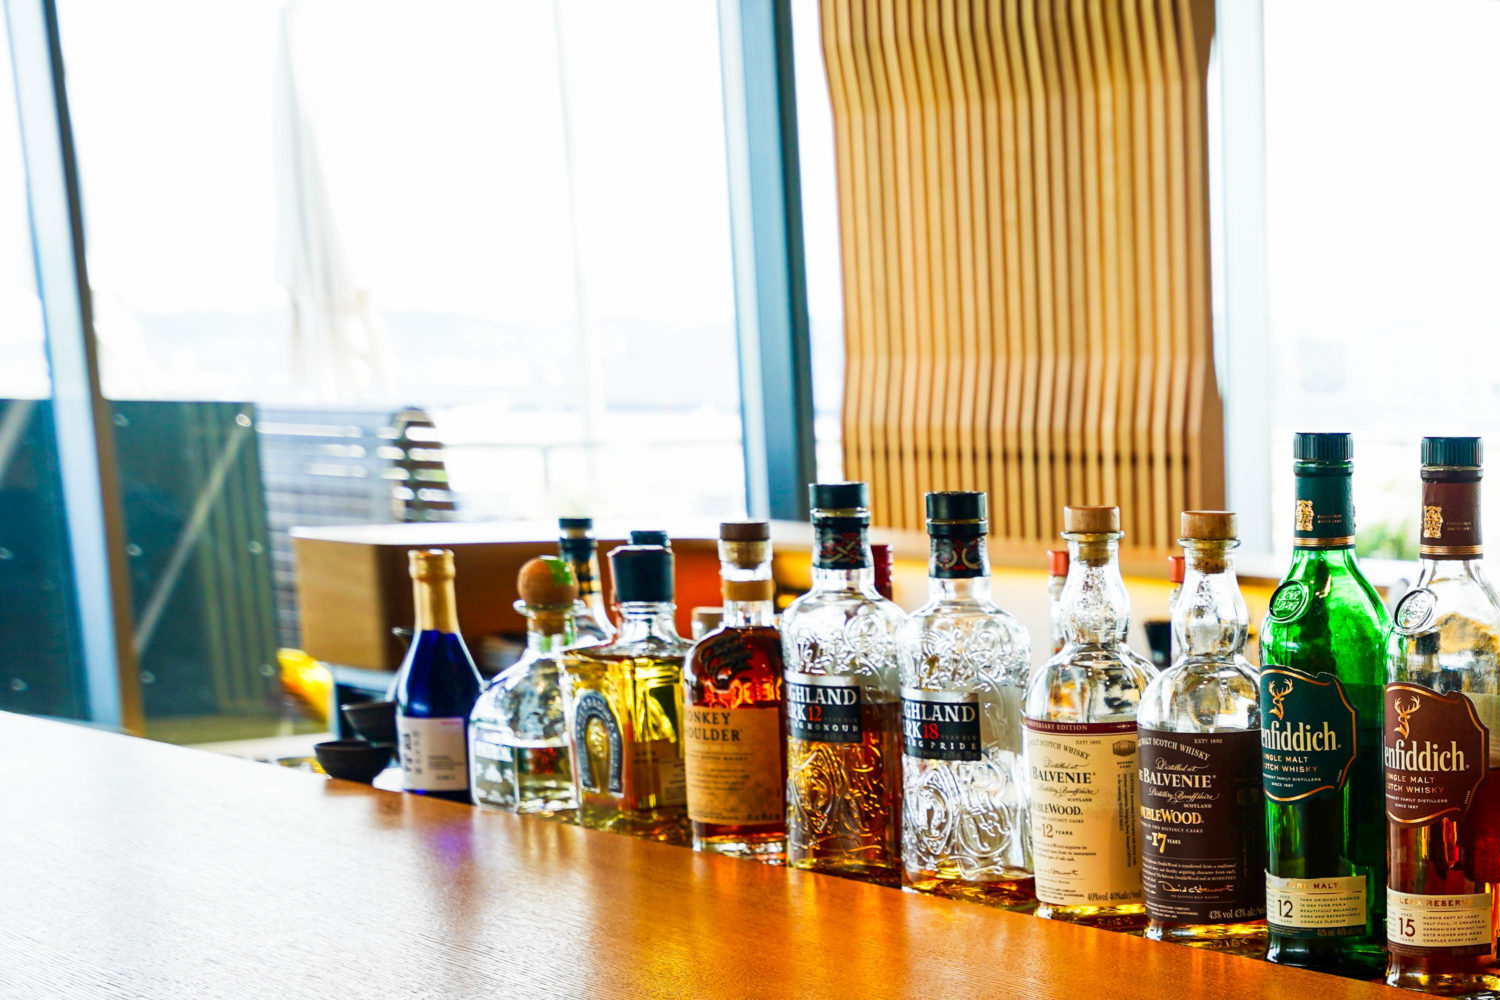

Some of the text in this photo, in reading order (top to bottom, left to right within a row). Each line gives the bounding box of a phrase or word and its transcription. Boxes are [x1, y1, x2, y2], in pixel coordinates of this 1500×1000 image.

[789, 685, 857, 705] GHLAND
[688, 711, 730, 725] ONKEY
[788, 701, 822, 722] RK 12
[903, 701, 976, 722] GHLAND
[689, 728, 740, 742] OULDER
[903, 719, 940, 740] RK 18
[1261, 720, 1337, 752] enfiddich
[930, 742, 977, 751] PRIDE
[1063, 744, 1090, 760] WHISKY
[1153, 737, 1211, 761] SCOTCH WHISKY
[1384, 739, 1466, 772] enfiddich
[1263, 753, 1282, 762] NGLE
[1032, 766, 1092, 784] BALVENIE
[1263, 763, 1279, 771] OTCH
[1144, 768, 1212, 788] BALVENIE
[1387, 773, 1435, 784] NGLE MALT
[1387, 783, 1403, 792] OTCH
[1034, 802, 1081, 815] BLEWOOD
[1140, 805, 1202, 825] UBLEWOOD
[1042, 823, 1053, 838] 12
[1151, 832, 1167, 853] 17
[1208, 910, 1222, 920] 43%
[1222, 909, 1233, 919] vol
[1277, 899, 1293, 918] 12
[1399, 918, 1416, 937] 15
